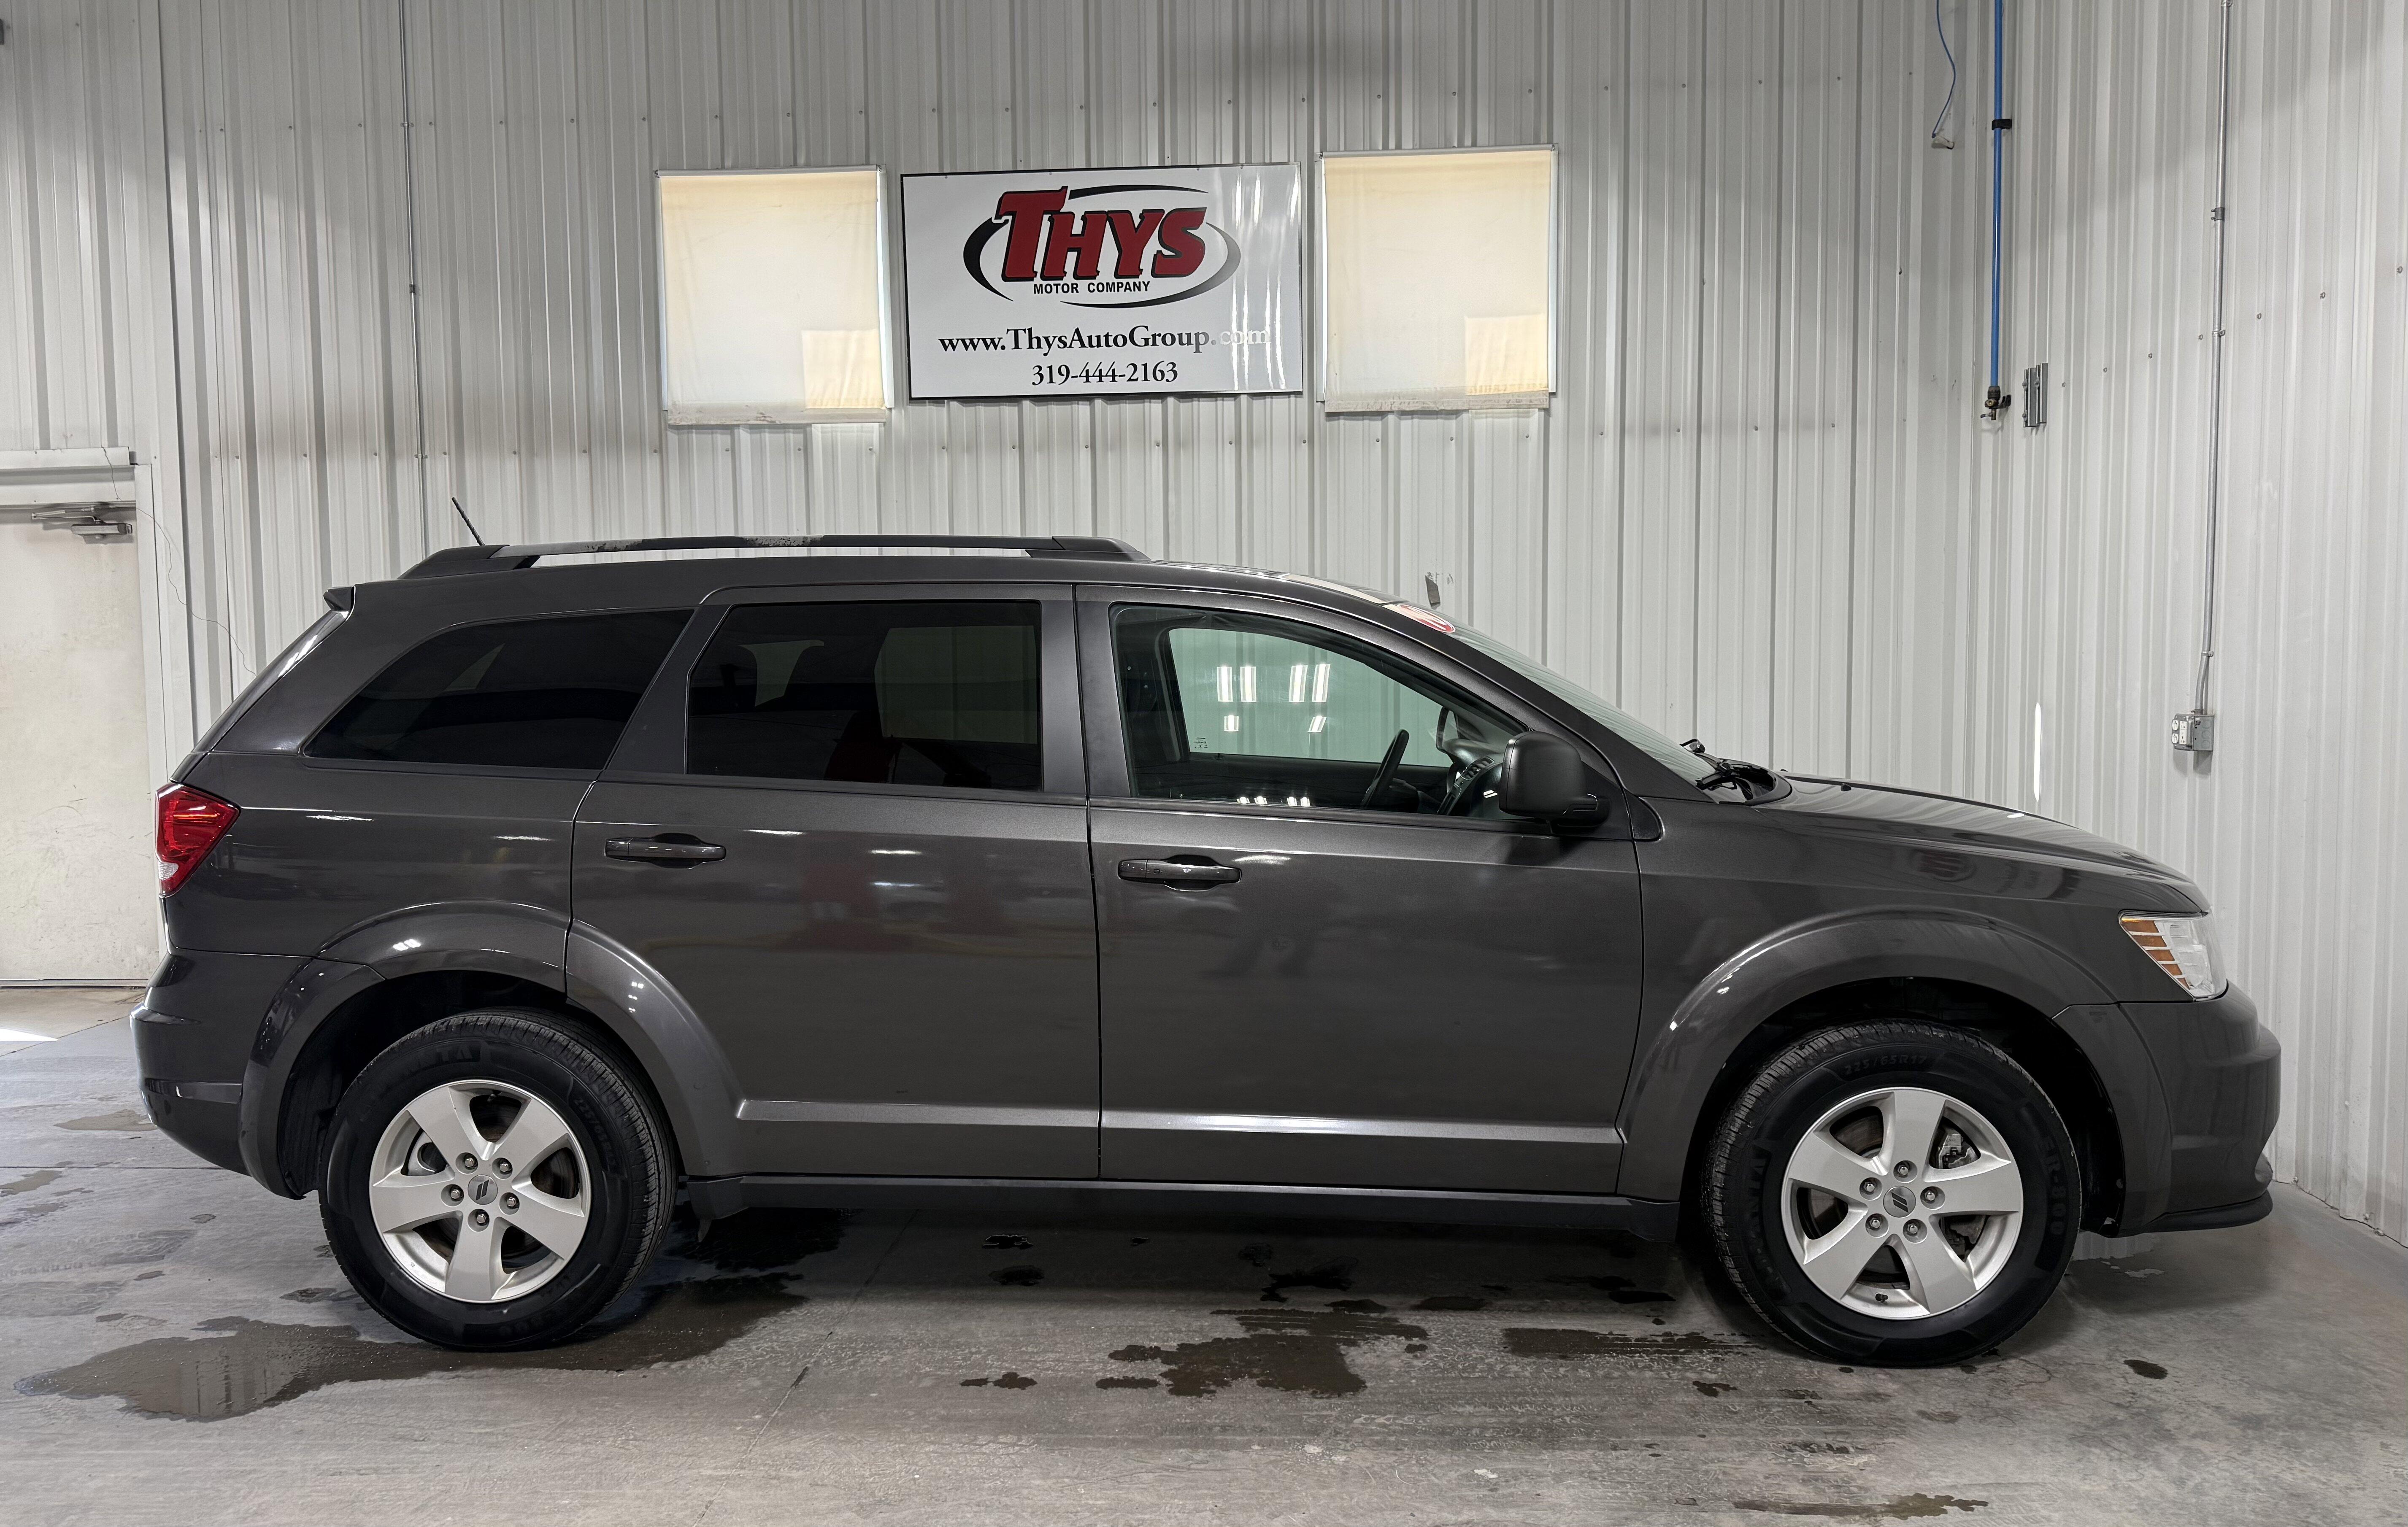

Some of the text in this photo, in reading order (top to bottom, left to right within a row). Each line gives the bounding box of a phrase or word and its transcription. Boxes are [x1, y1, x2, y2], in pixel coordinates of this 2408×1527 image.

[995, 186, 1207, 282] THYS
[1034, 281, 1151, 294] MOTOR COMPANY
[938, 325, 1271, 356] www.ThysAutoGroup.com
[1032, 361, 1178, 386] 319-444-2163
